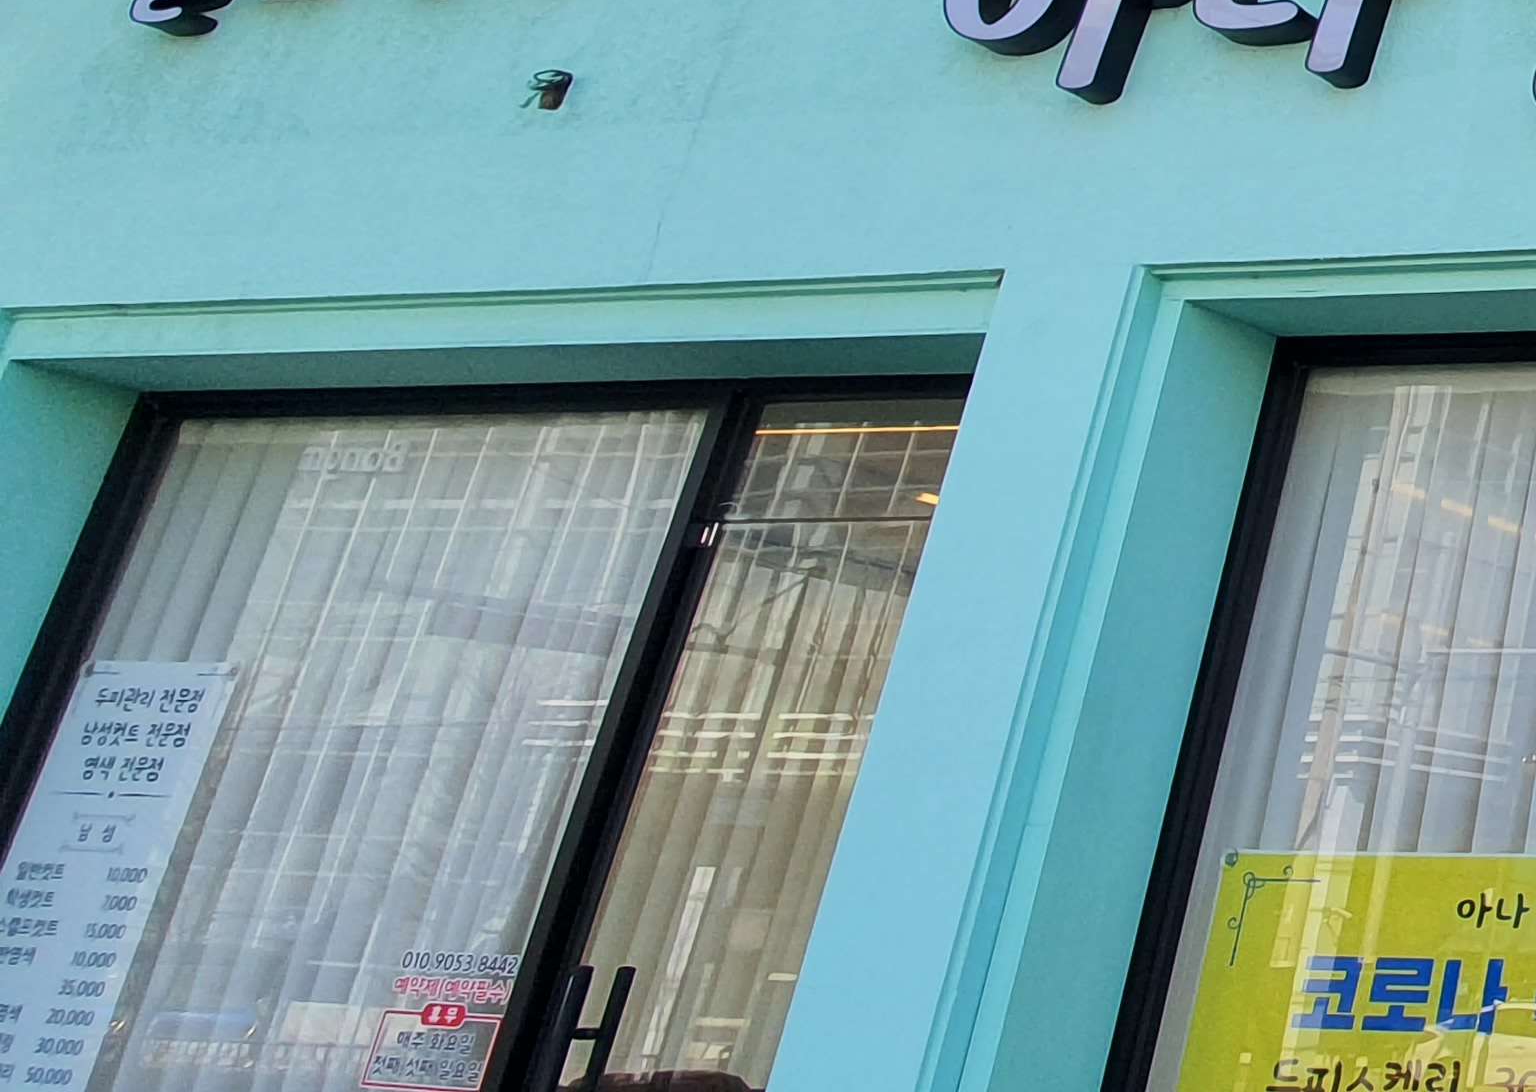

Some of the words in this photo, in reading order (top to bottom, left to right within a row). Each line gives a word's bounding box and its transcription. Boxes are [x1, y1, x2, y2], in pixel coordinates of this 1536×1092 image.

[95, 688, 153, 712] 두피관리
[160, 688, 206, 713] 전문점
[146, 722, 191, 747] 전문점
[119, 757, 164, 782] 전문점
[1456, 892, 1530, 929] 아나
[1292, 956, 1509, 1034] 코로나
